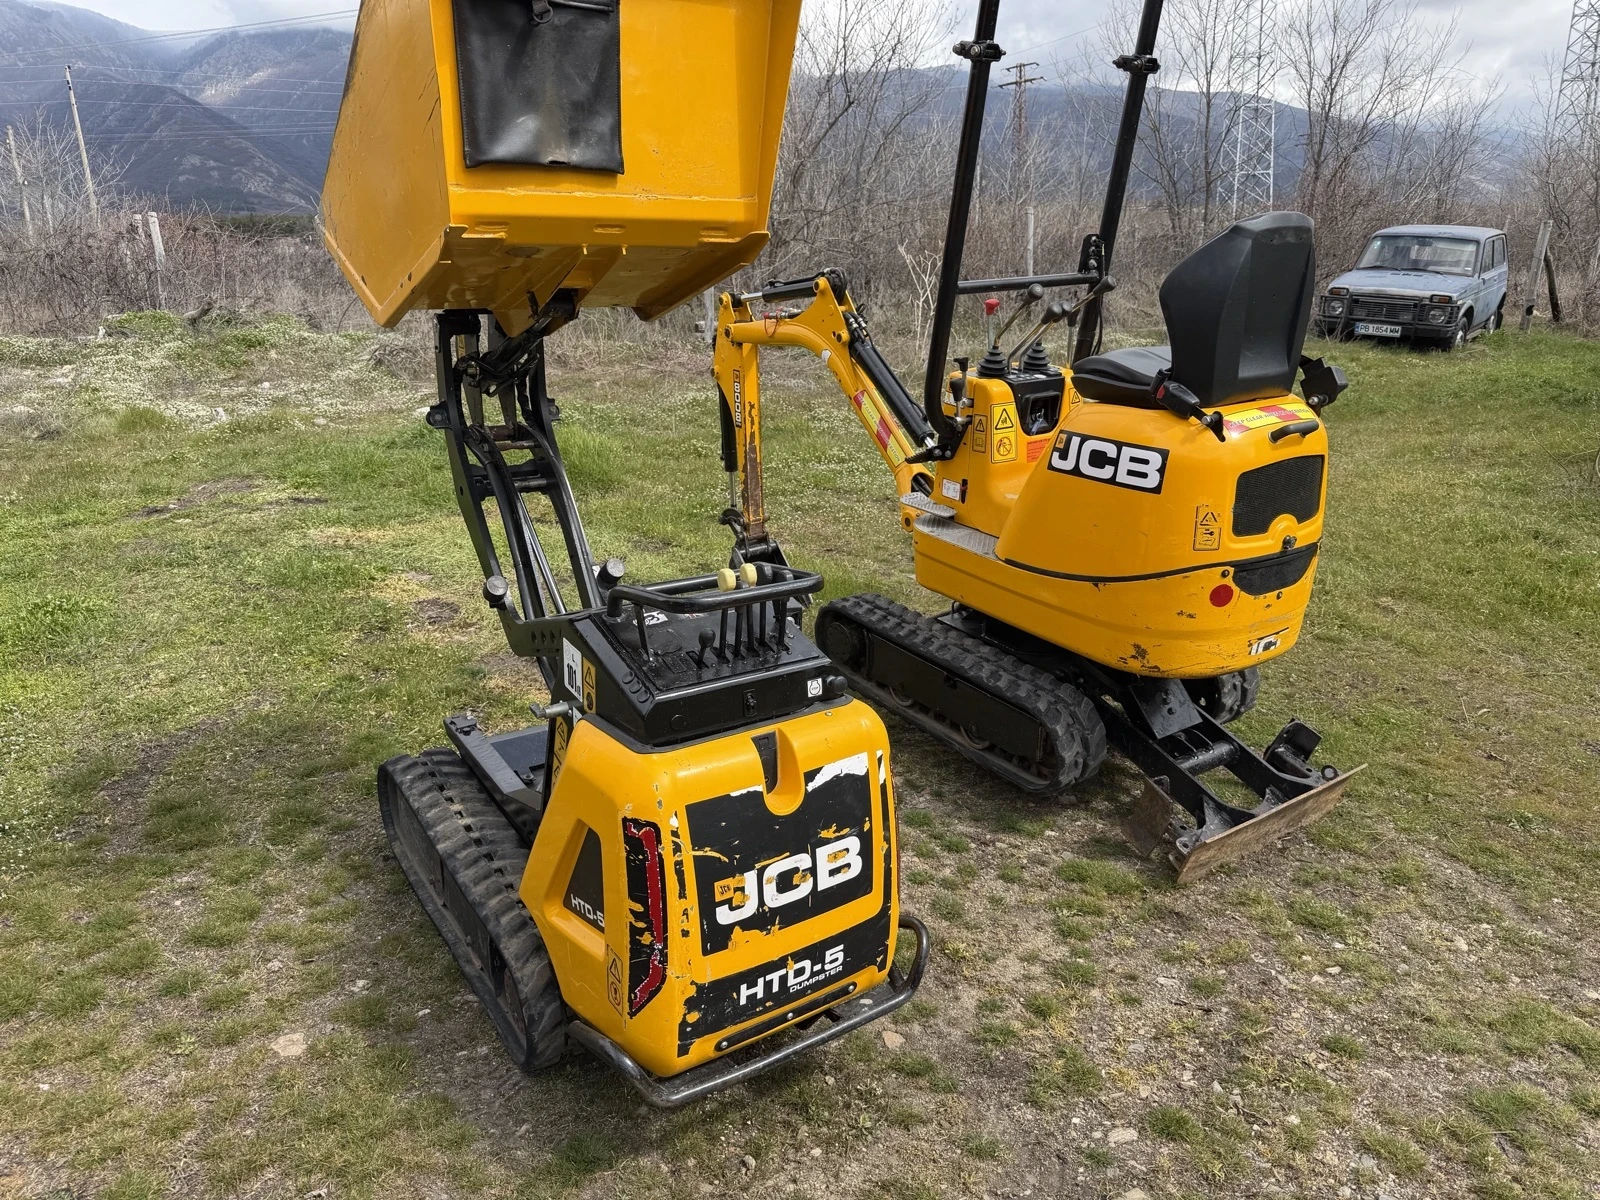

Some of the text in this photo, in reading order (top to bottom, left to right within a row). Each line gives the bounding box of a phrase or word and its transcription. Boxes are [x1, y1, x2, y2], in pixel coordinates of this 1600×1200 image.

[734, 382, 742, 422] 8008
[1246, 414, 1264, 422] CLEAR
[1051, 436, 1163, 489] JCB
[567, 663, 577, 693] 101
[715, 836, 863, 925] JCB
[719, 884, 731, 896] JCB
[570, 893, 605, 928] HTD-5
[739, 944, 845, 1006] HTD-5
[789, 965, 843, 993] DUMPSTER
